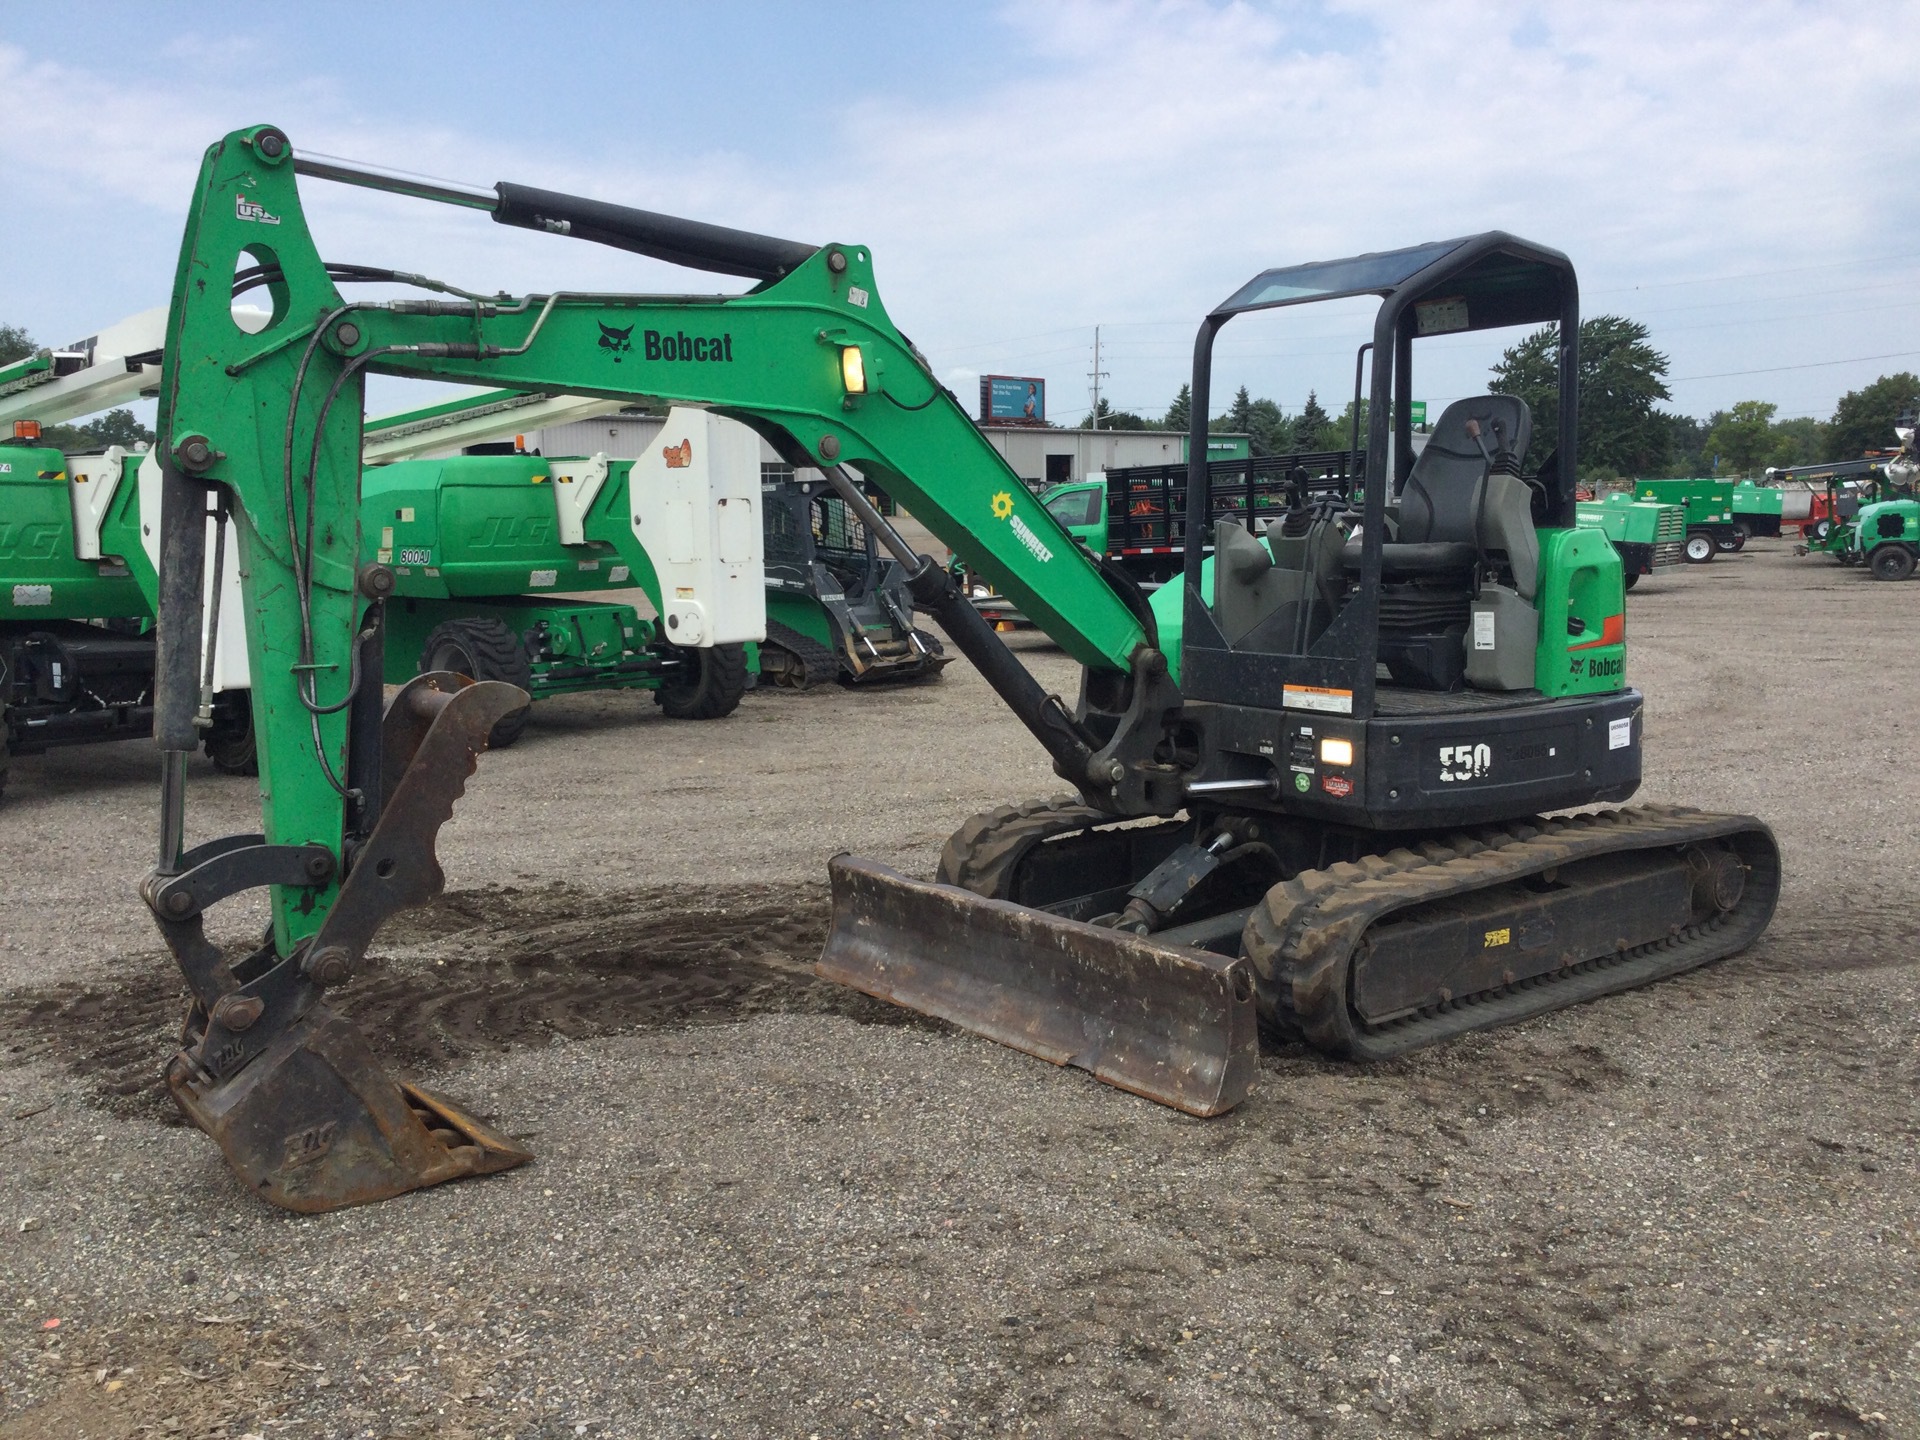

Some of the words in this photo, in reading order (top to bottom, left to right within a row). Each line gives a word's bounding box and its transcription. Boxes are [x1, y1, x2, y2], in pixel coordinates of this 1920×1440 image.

[644, 330, 733, 362] Bobcat
[467, 516, 552, 548] JLG
[1010, 515, 1054, 563] SUNBELT
[1012, 529, 1042, 562] RENTALS
[400, 549, 431, 565] 800AJ
[1439, 743, 1491, 782] E50
